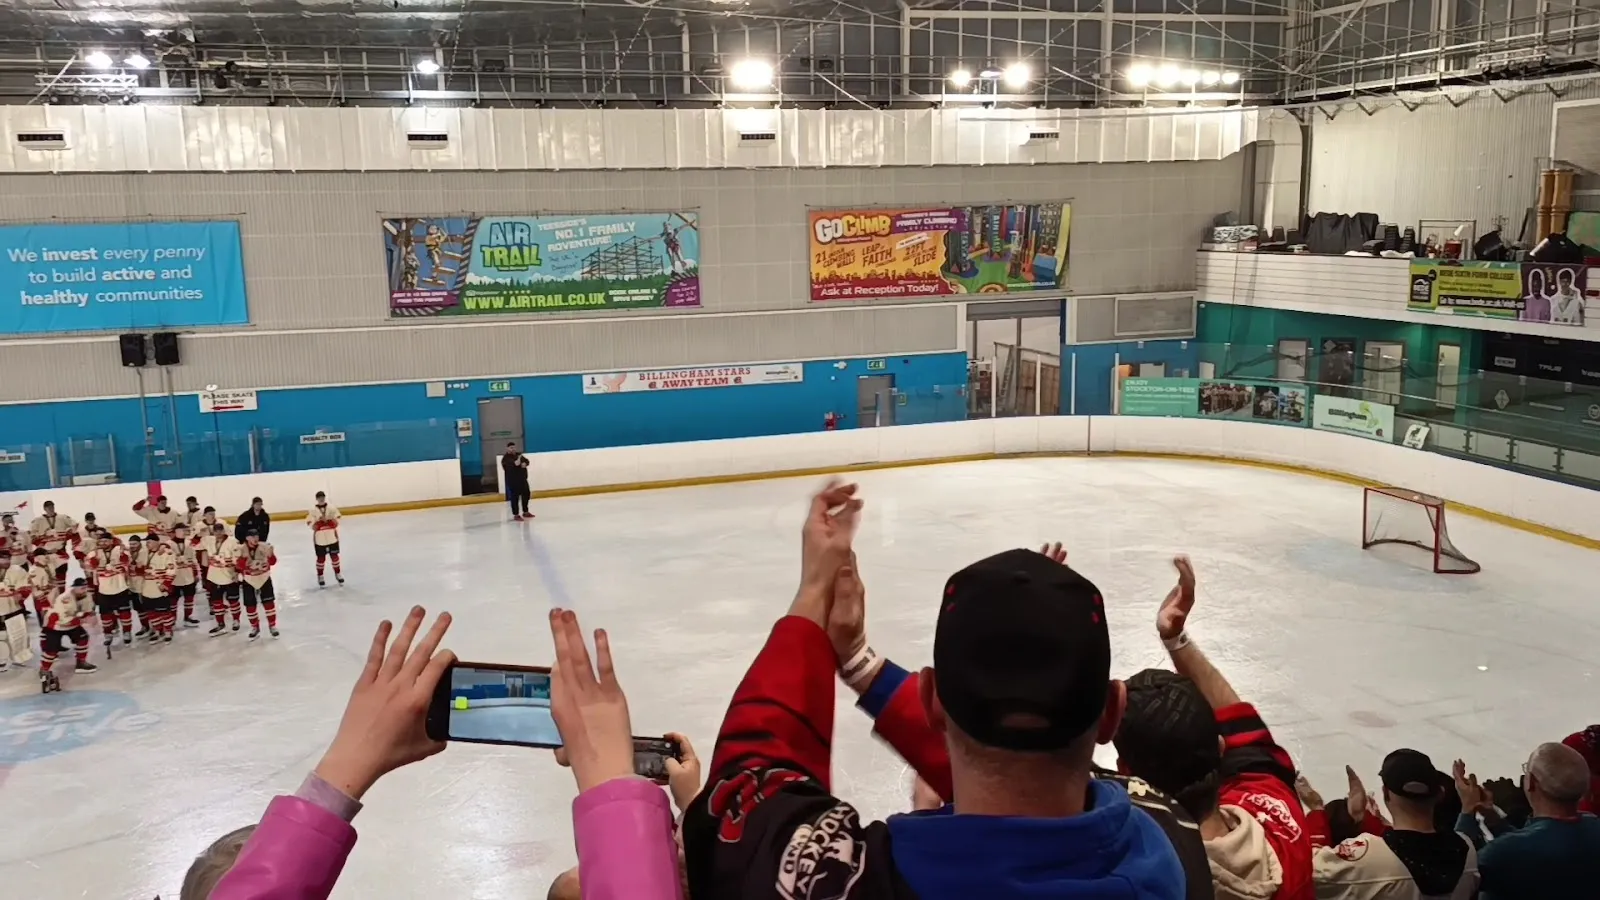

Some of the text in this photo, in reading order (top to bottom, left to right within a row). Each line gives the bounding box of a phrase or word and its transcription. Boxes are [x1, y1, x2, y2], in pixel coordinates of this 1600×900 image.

[489, 221, 530, 246] AIR
[588, 222, 635, 237] FAMILY
[7, 245, 205, 263] We invest every penny
[480, 244, 542, 267] TRAIL
[815, 250, 827, 264] 21
[862, 248, 892, 268] FAITH
[913, 249, 937, 267] SLIDE
[28, 265, 192, 284] to build active and
[20, 286, 203, 307] healthy communities
[820, 287, 840, 296] Ask
[842, 287, 852, 295] at
[854, 284, 905, 295] Reception
[907, 283, 939, 293] Today!
[464, 292, 606, 310] WWW.AIRTRAIL.CO.UK
[639, 366, 751, 381] BILLINGHAM STARS
[662, 376, 729, 388] AWAY TEAM
[796, 805, 851, 894] HOCKEY
